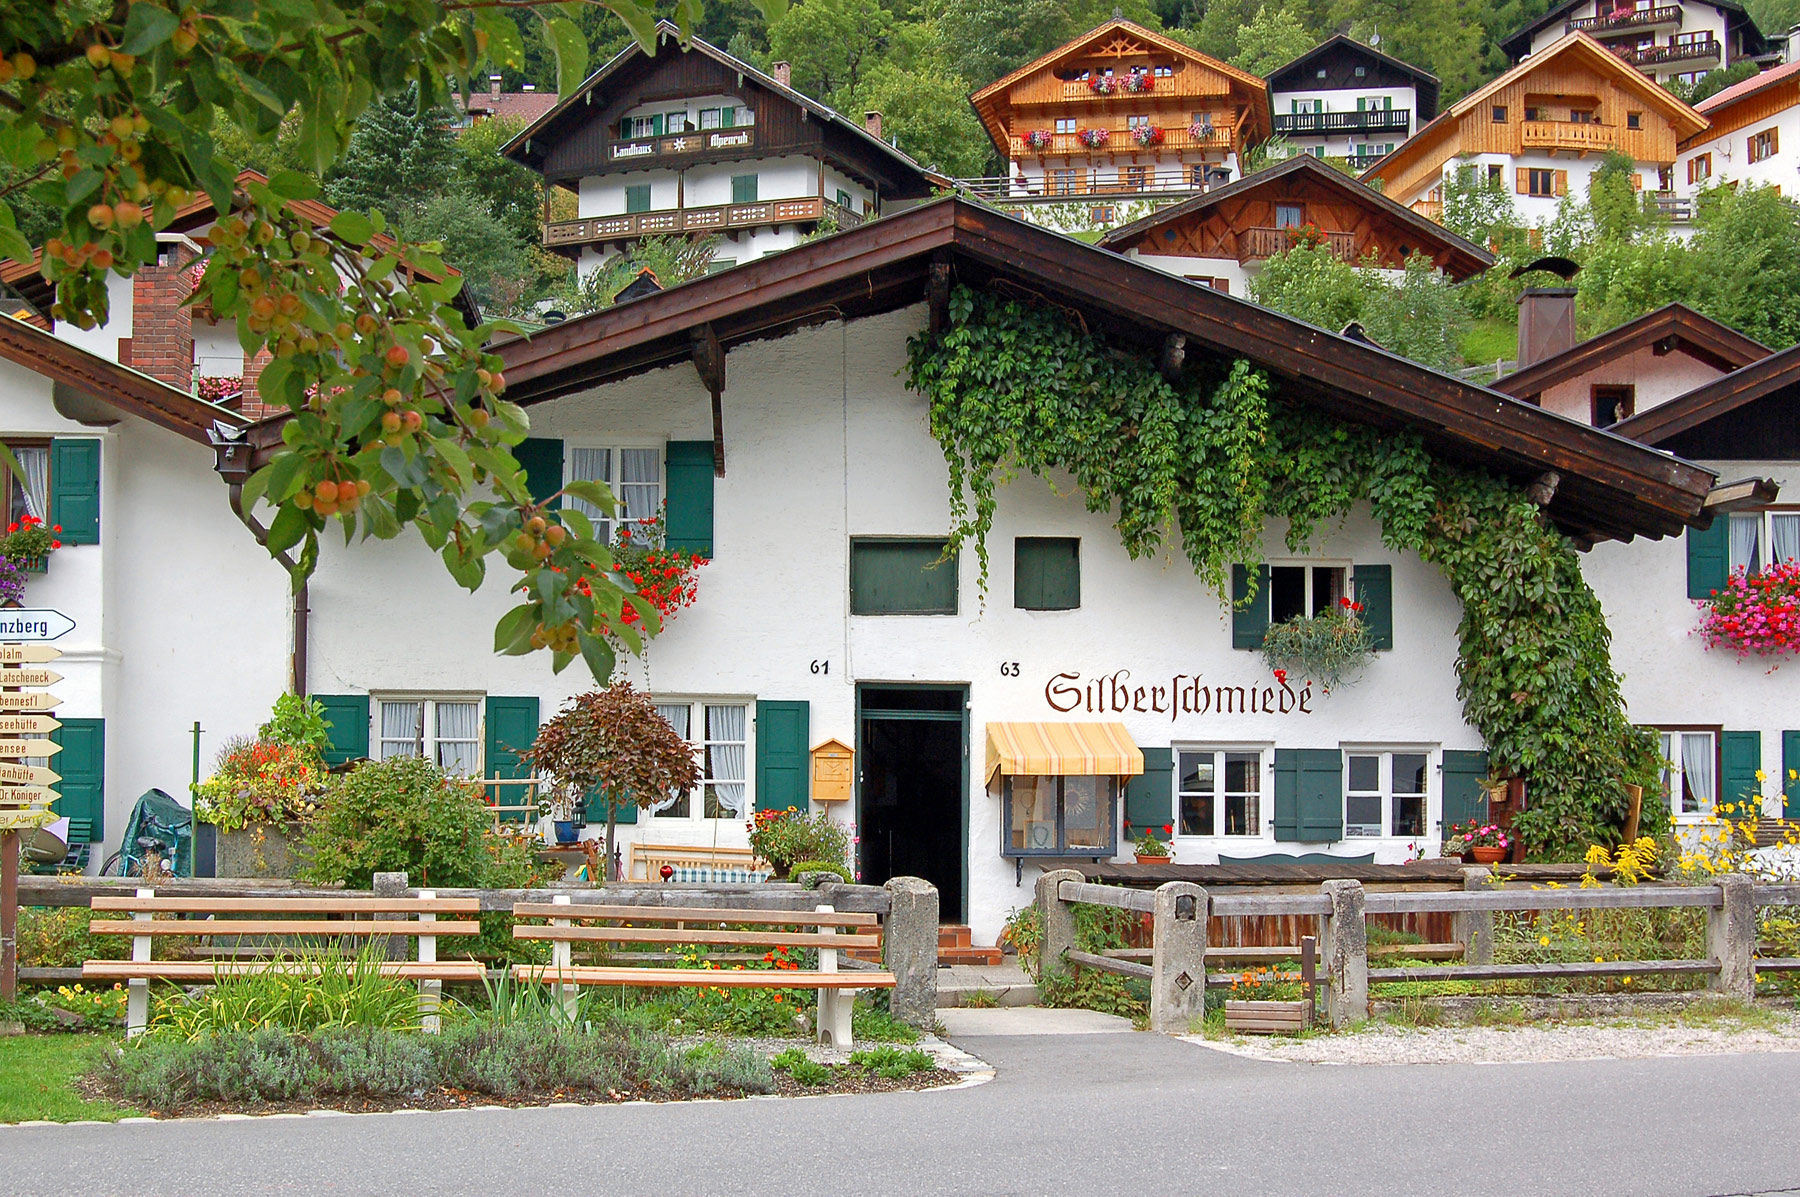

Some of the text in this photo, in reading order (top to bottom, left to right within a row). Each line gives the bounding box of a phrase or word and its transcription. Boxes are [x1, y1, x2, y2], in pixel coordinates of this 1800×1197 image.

[613, 131, 748, 158] Landhaus Alpenruh
[0, 618, 47, 637] nzberg
[810, 659, 830, 675] 61
[1000, 661, 1020, 677] 63
[1045, 669, 1313, 723] Silberschmiede
[0, 718, 38, 729] seehütte
[11, 788, 42, 803] Königer
